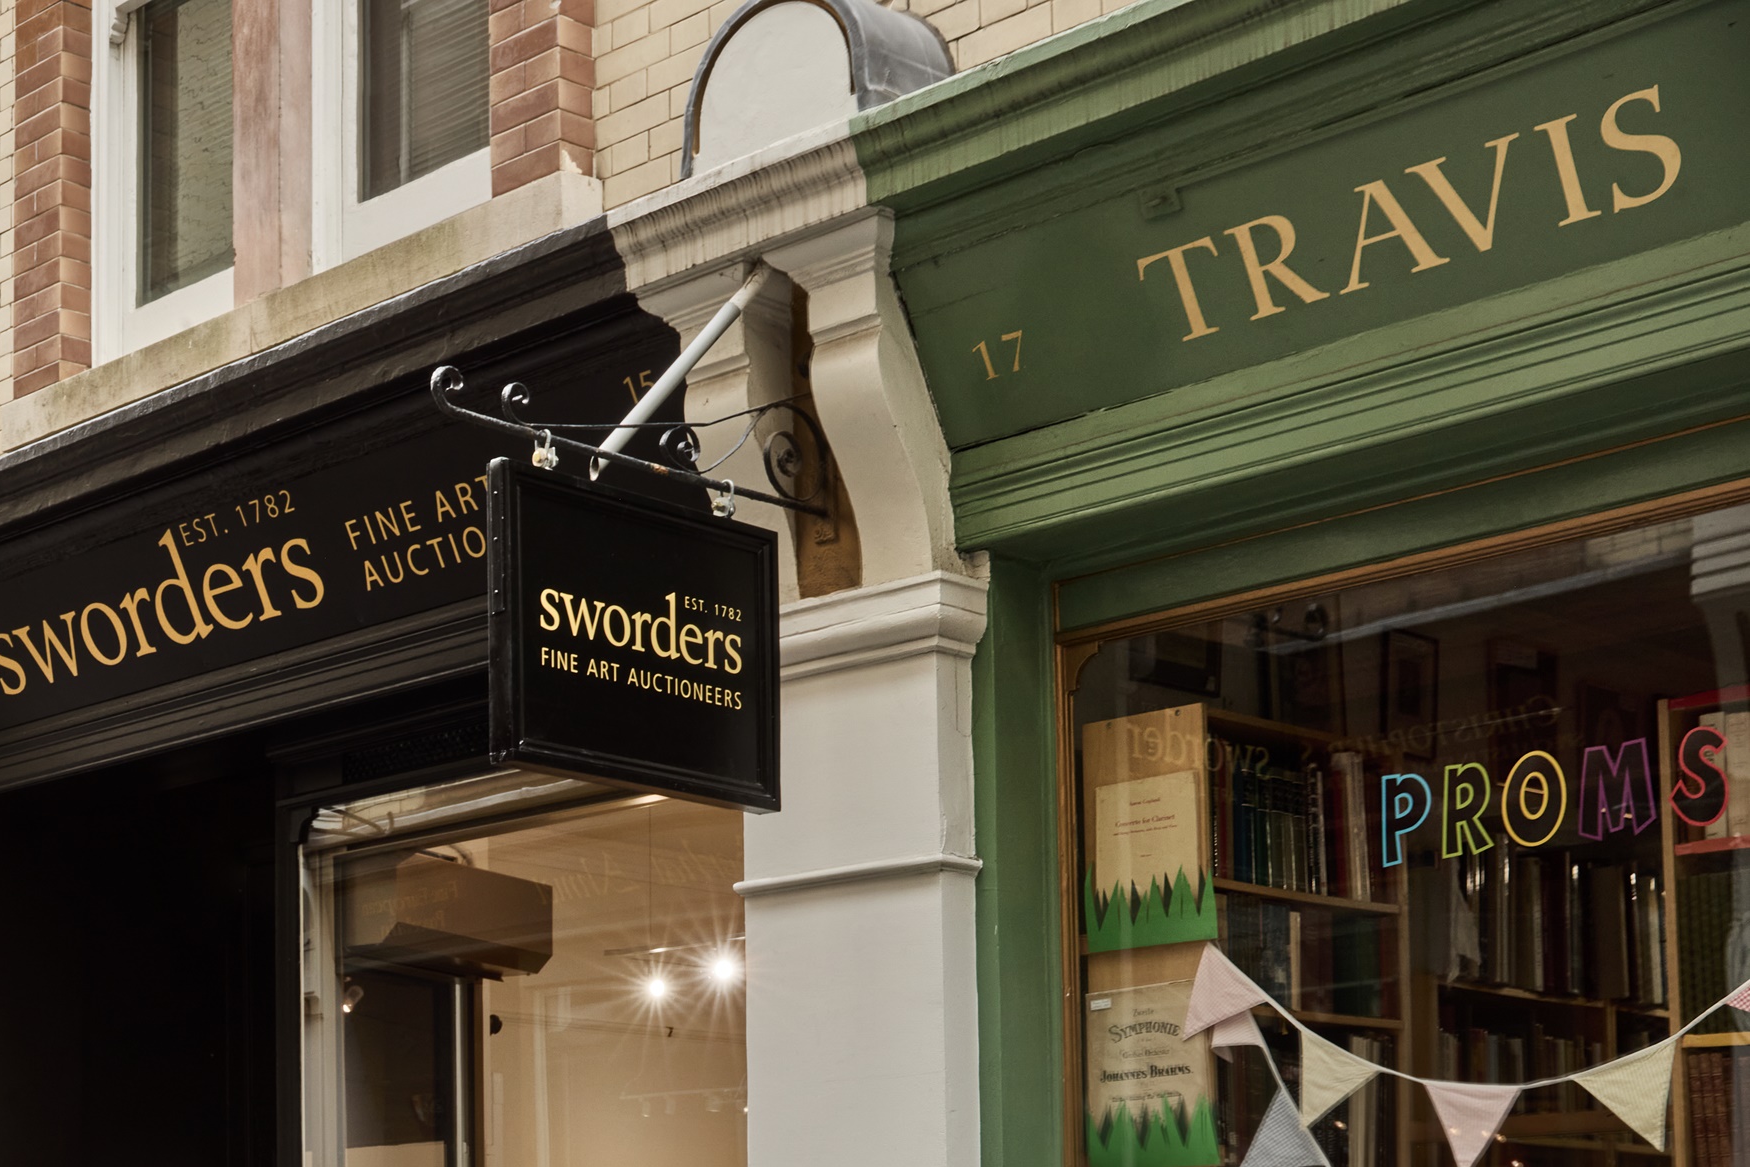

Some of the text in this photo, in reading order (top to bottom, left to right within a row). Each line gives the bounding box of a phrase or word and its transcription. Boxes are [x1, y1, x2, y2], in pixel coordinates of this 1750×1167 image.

[1136, 84, 1682, 342] TRAVIS
[971, 330, 1024, 381] 17
[623, 369, 655, 405] 15
[179, 489, 296, 546] EST. 1782
[344, 473, 489, 551] FINE ART
[540, 588, 742, 675] sworders
[684, 596, 742, 622] EST. 1782
[541, 647, 742, 710] FINE ART AUCTIONEERS
[1381, 727, 1729, 868] PROMS
[1108, 1021, 1181, 1043] SYMPHONIE
